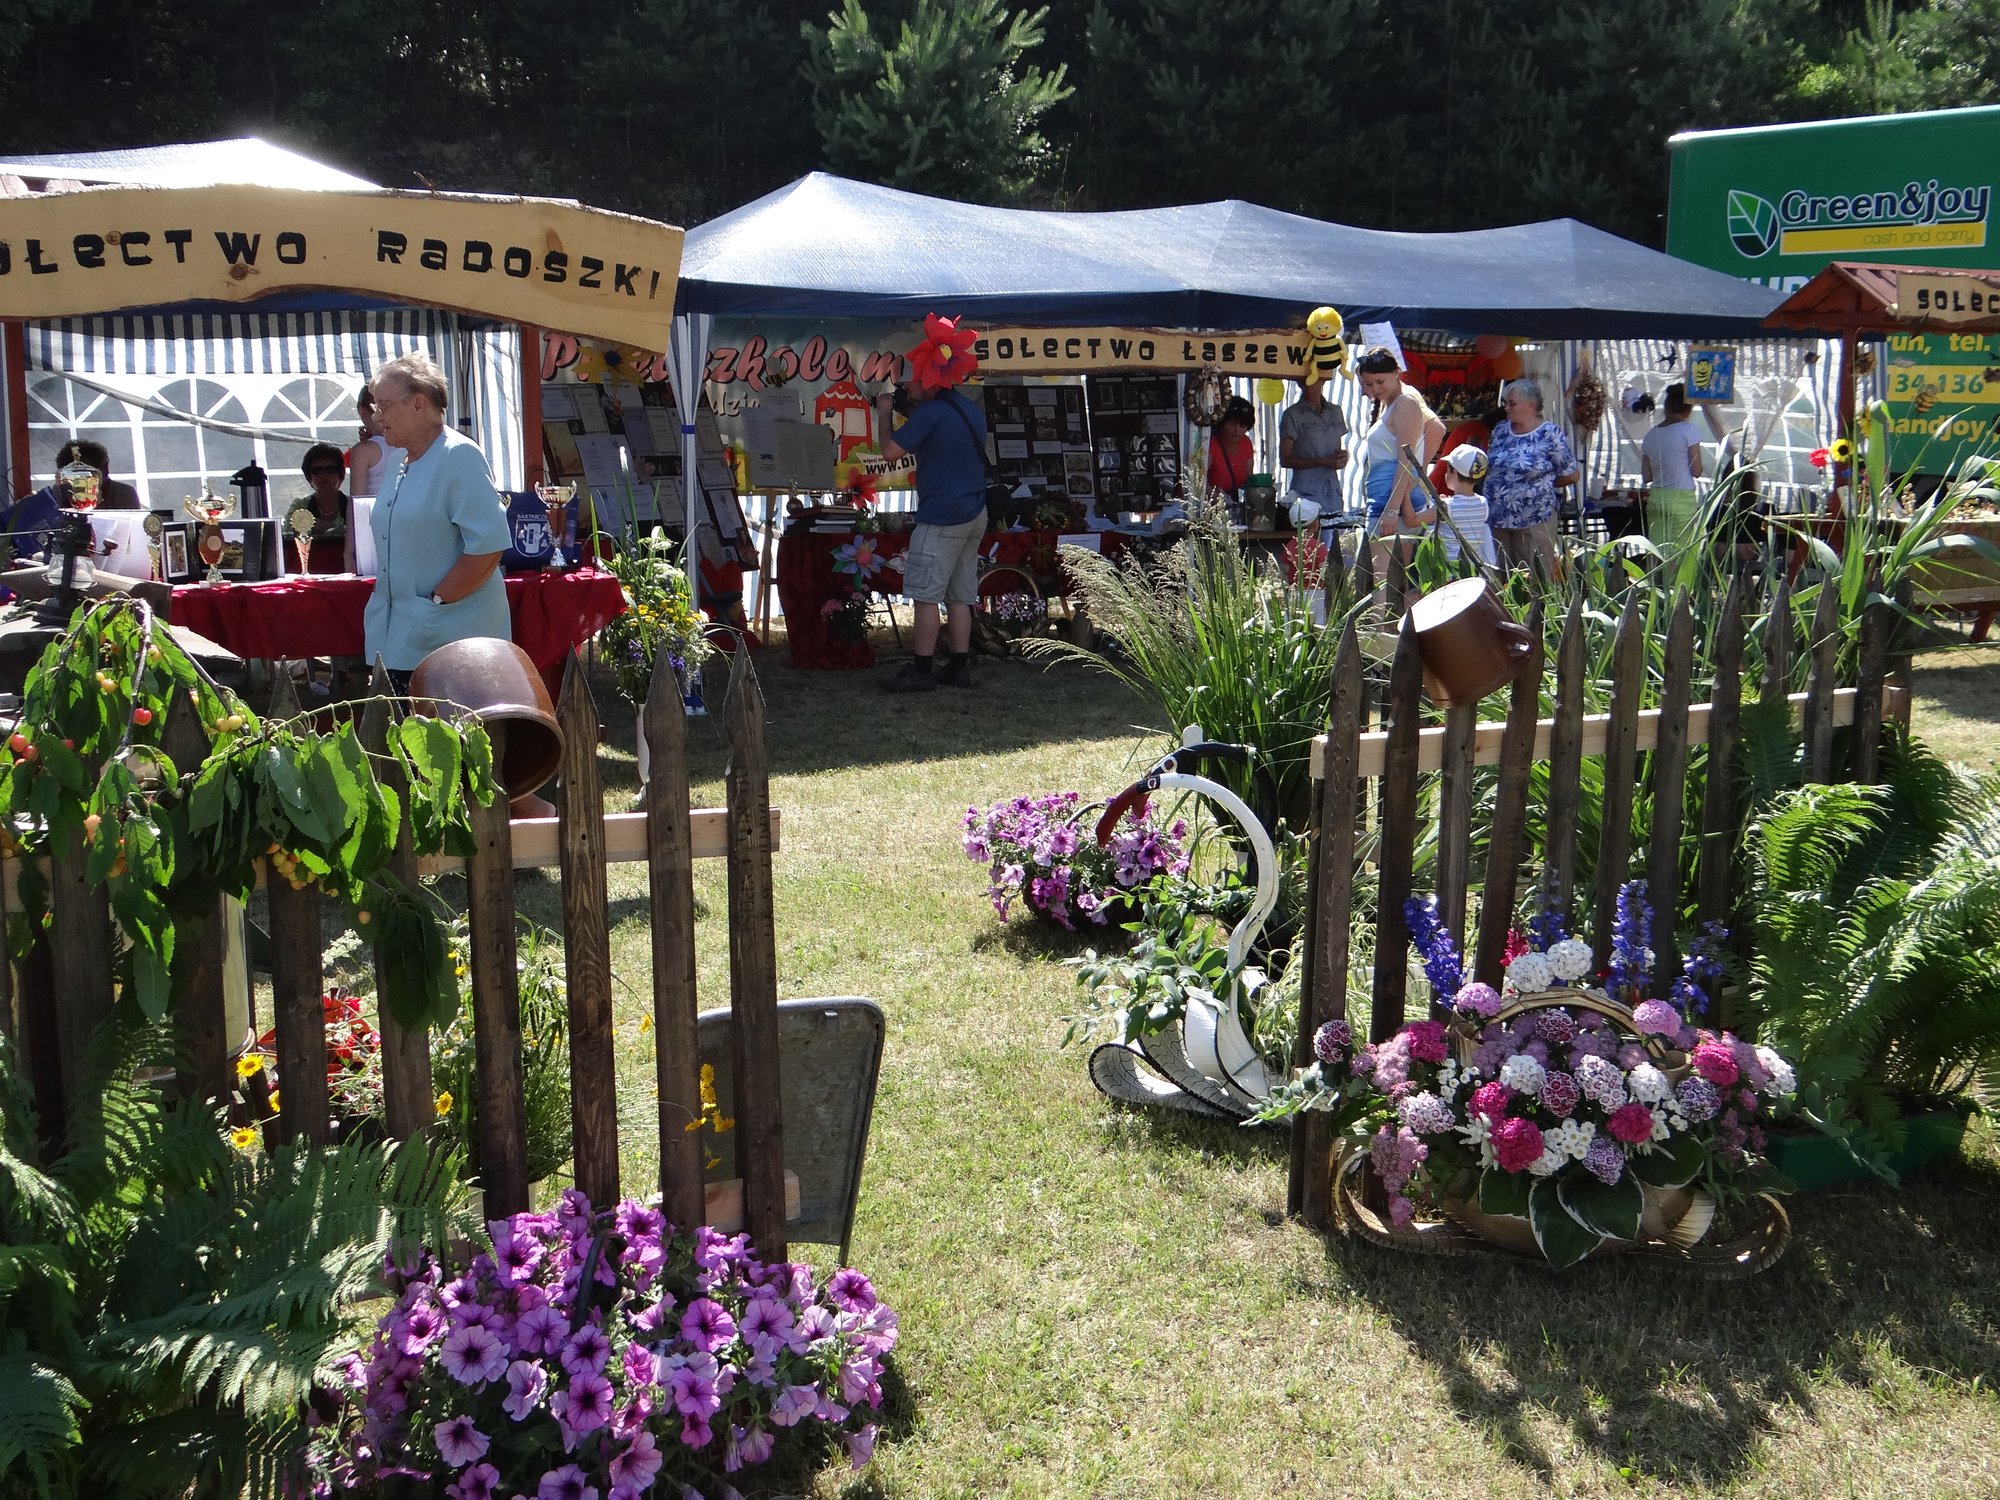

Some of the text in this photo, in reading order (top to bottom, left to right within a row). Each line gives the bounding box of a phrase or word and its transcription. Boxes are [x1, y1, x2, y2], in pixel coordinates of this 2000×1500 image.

[1779, 179, 1991, 225] Green&joy
[1863, 229, 1976, 245] cash and carry
[1949, 333, 1991, 352] tel.
